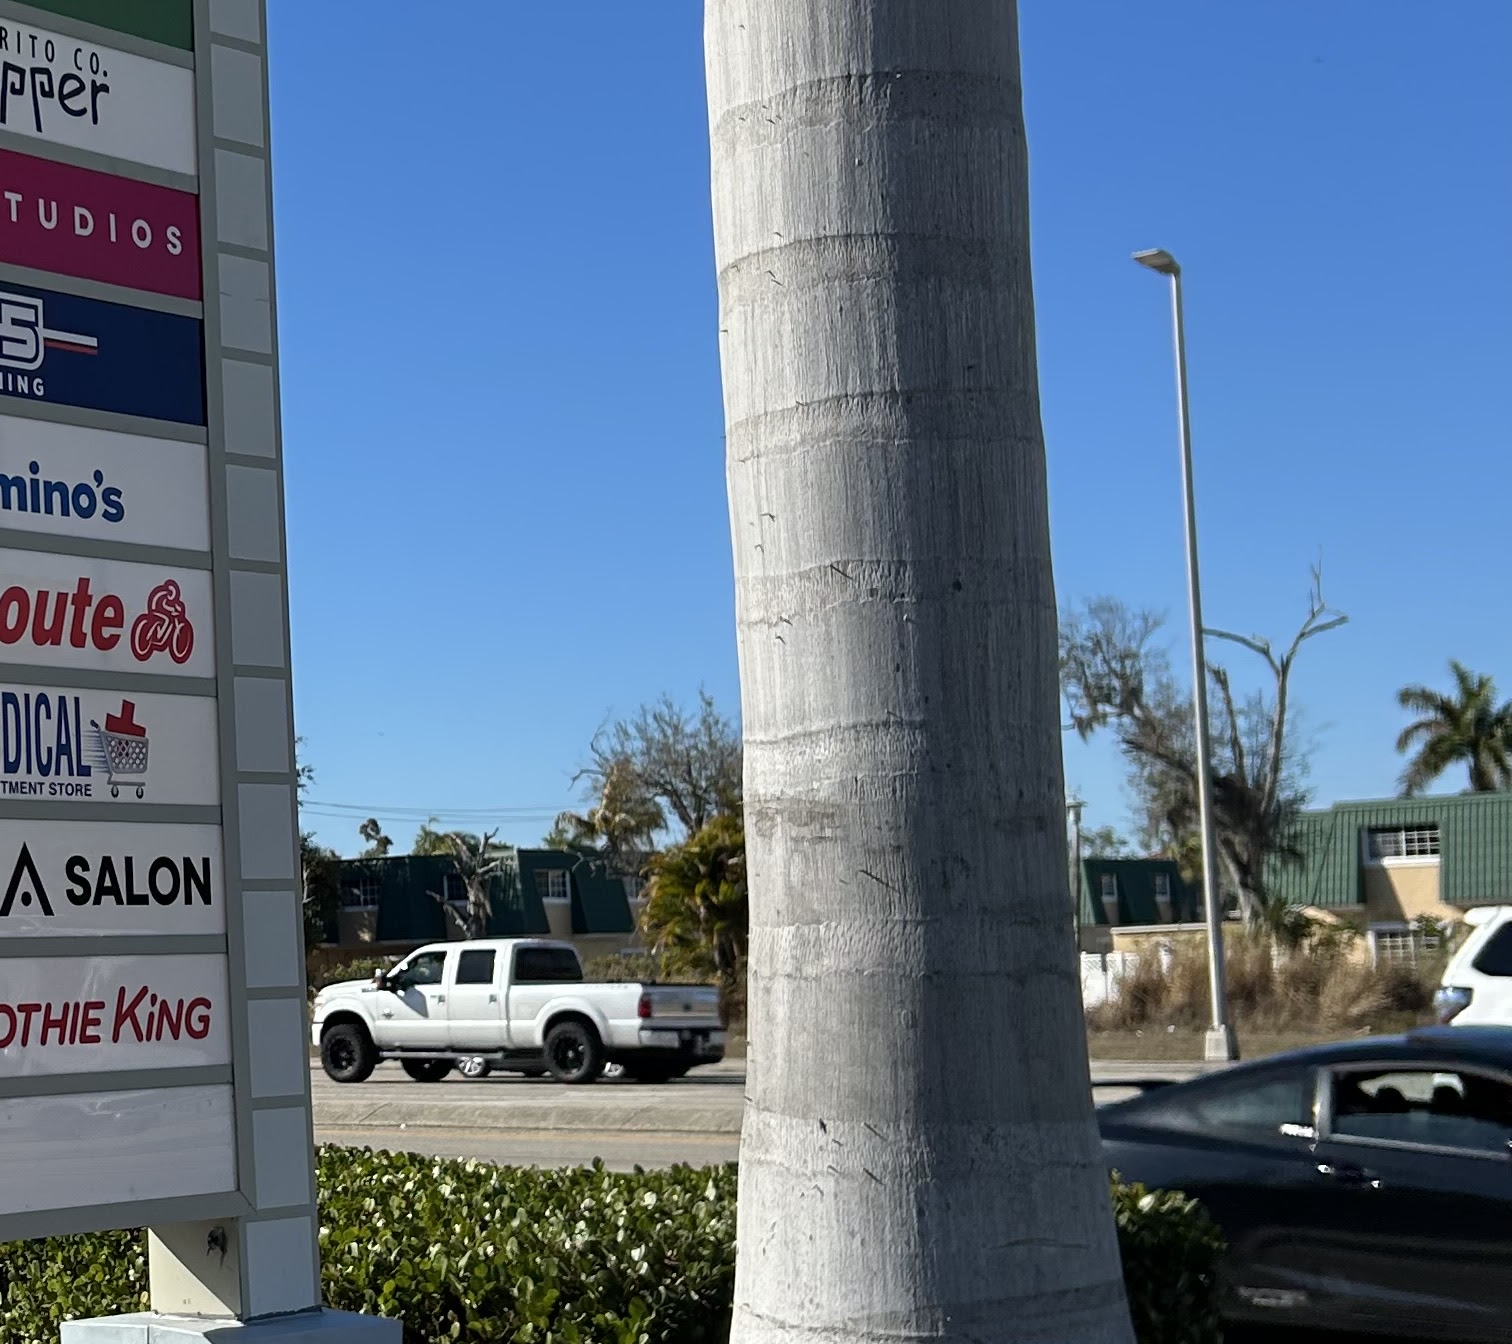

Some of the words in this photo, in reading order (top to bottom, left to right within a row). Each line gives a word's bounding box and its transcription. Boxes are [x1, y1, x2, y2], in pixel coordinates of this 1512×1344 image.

[73, 47, 109, 78] CO.
[48, 782, 93, 797] STORE
[65, 856, 212, 906] SALON
